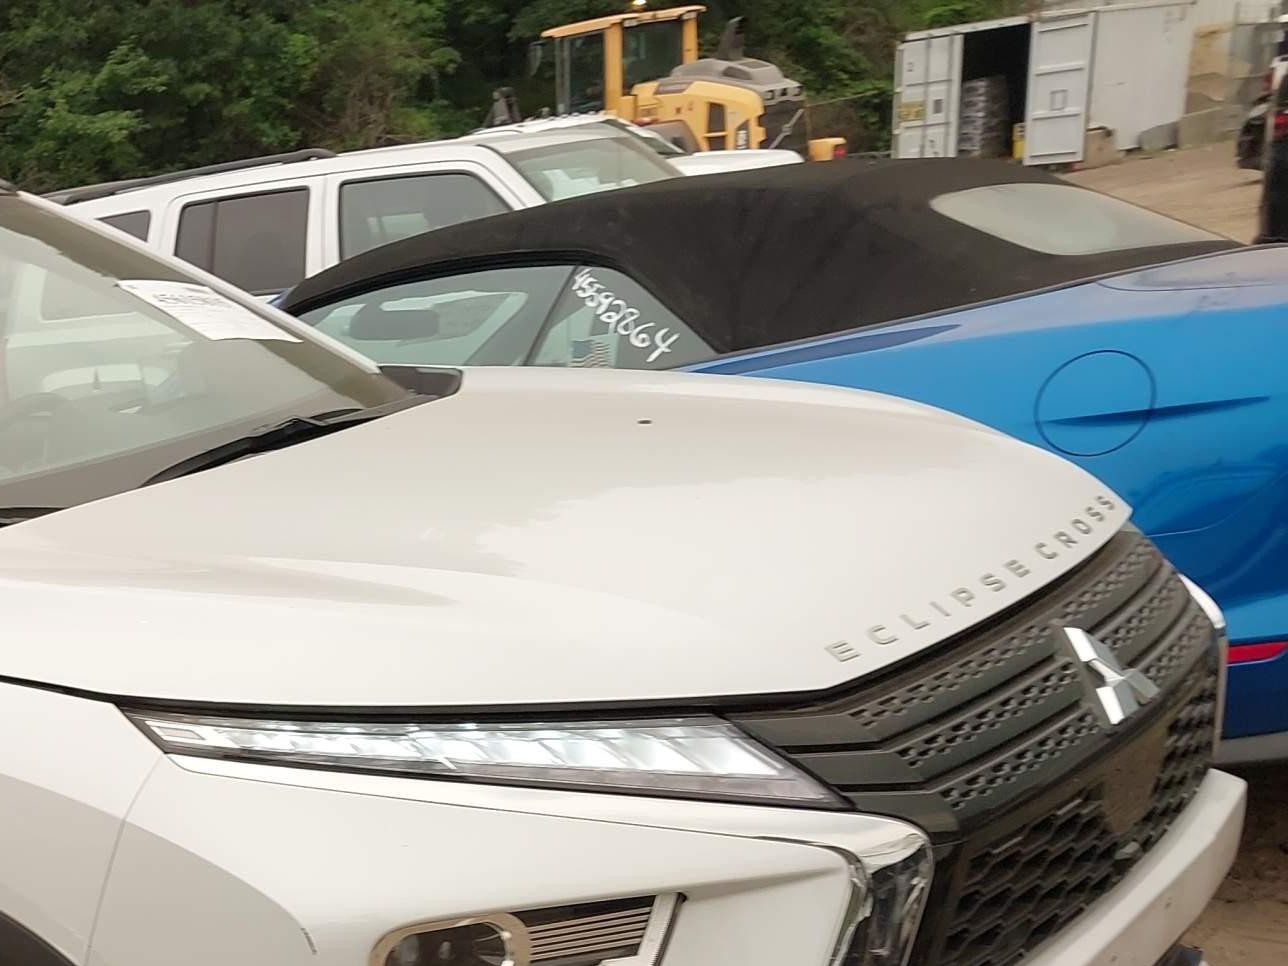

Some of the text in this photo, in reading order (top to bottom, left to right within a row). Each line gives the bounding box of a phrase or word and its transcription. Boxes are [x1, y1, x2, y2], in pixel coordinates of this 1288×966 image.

[572, 268, 680, 363] 45592864
[824, 495, 1115, 662] ECLIPSE CROSS
